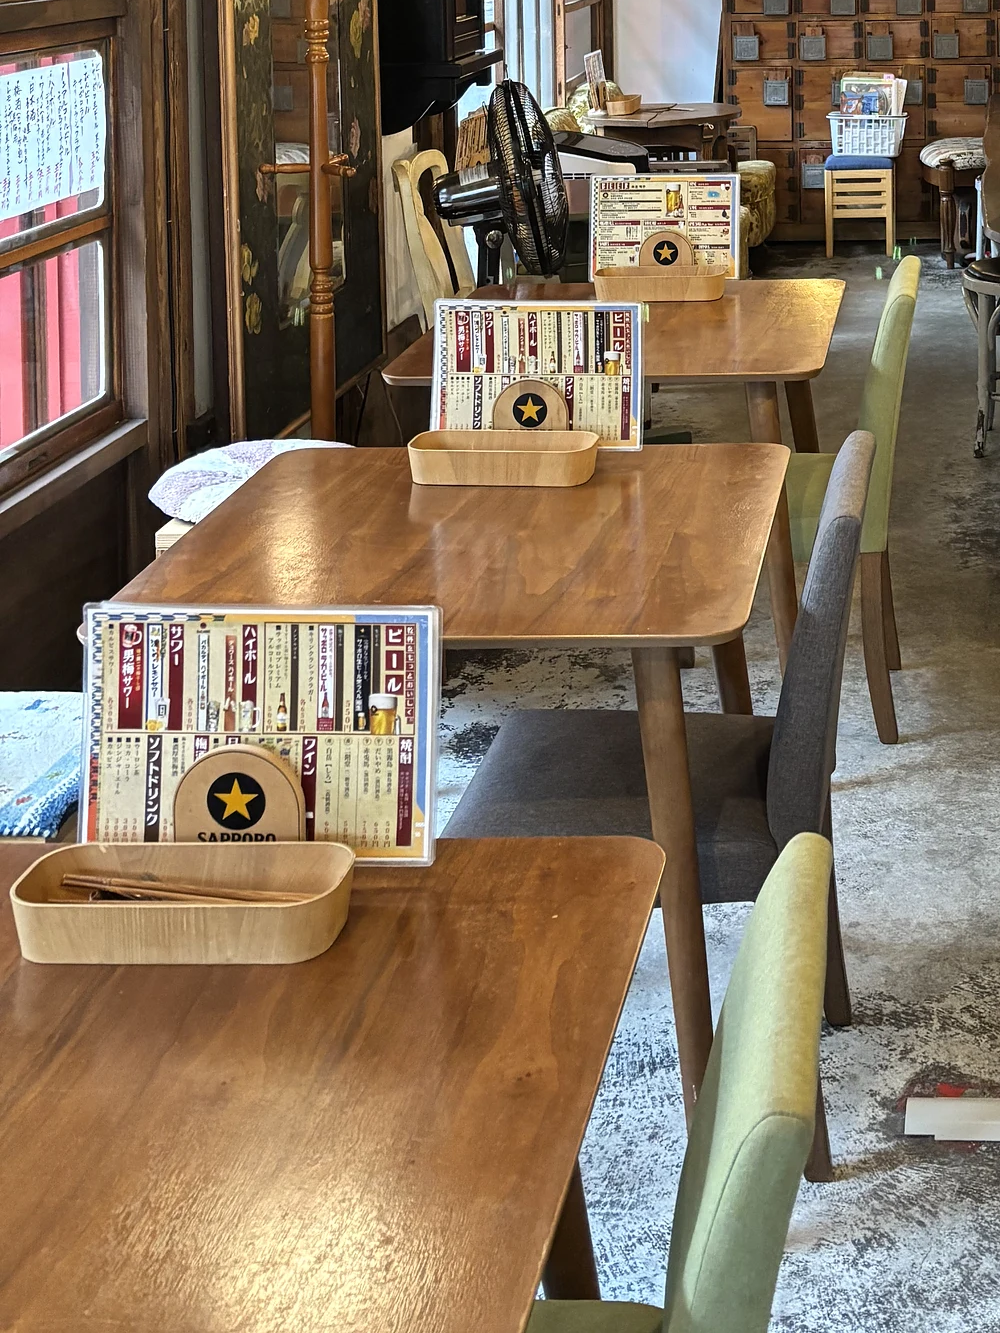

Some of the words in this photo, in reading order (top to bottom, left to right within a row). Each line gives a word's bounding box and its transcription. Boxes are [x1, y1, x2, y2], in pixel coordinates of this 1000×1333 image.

[565, 378, 573, 399] ワイン
[170, 626, 183, 666] サワー
[244, 626, 257, 685] ハイボール
[386, 628, 403, 692] ビール
[121, 648, 135, 709] 男梅サワー
[303, 738, 316, 775] ワイン
[400, 739, 413, 765] 焼酎
[146, 737, 160, 826] ソフトドリンク
